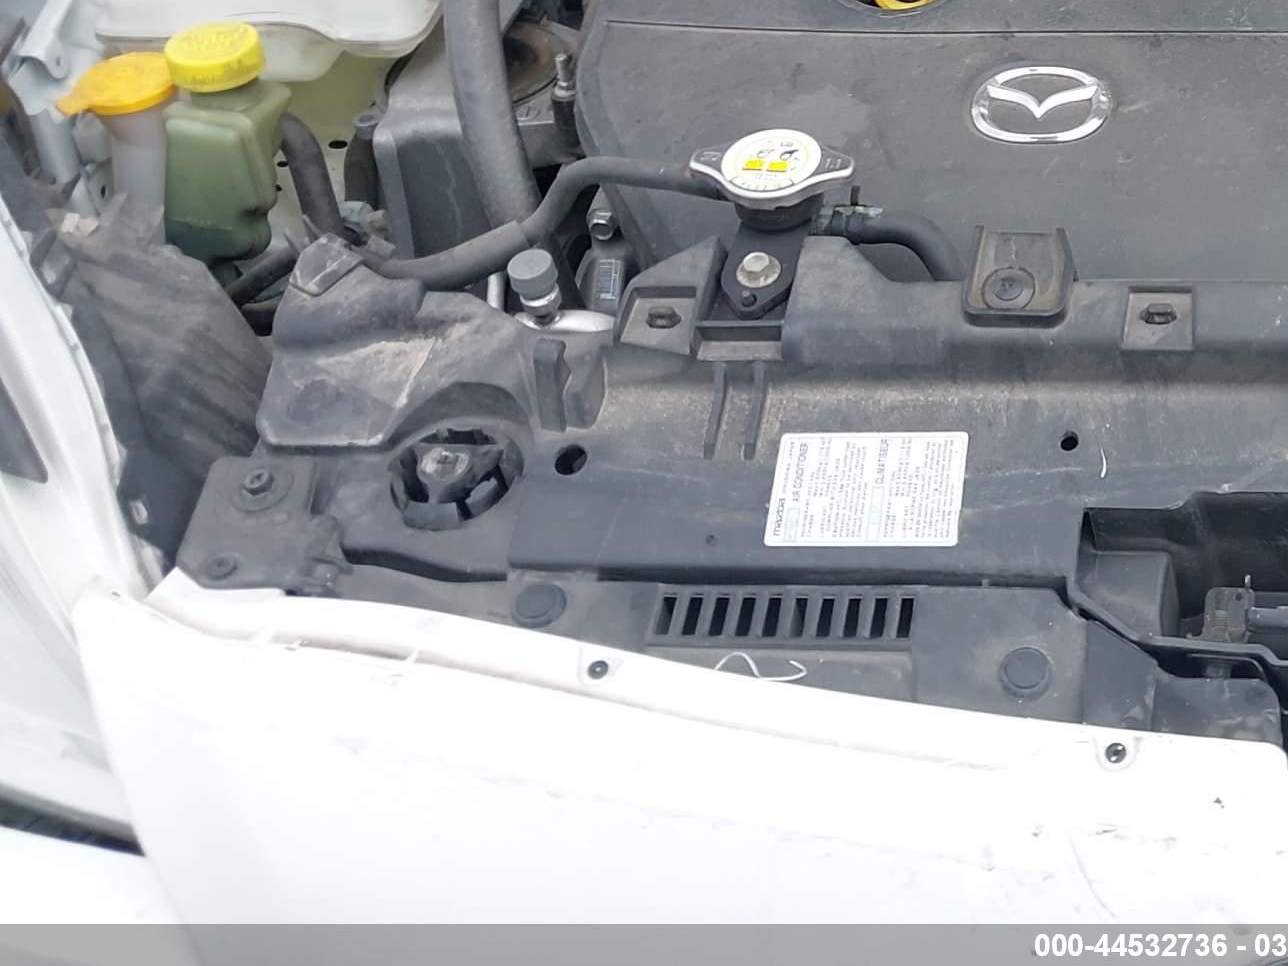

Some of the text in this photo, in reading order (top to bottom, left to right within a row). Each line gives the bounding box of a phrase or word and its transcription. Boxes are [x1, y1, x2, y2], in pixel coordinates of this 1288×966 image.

[793, 442, 808, 489] CONDITIONER
[874, 439, 888, 484] CLIMATISEUR
[792, 490, 800, 502] AIR
[773, 498, 786, 536] mazda
